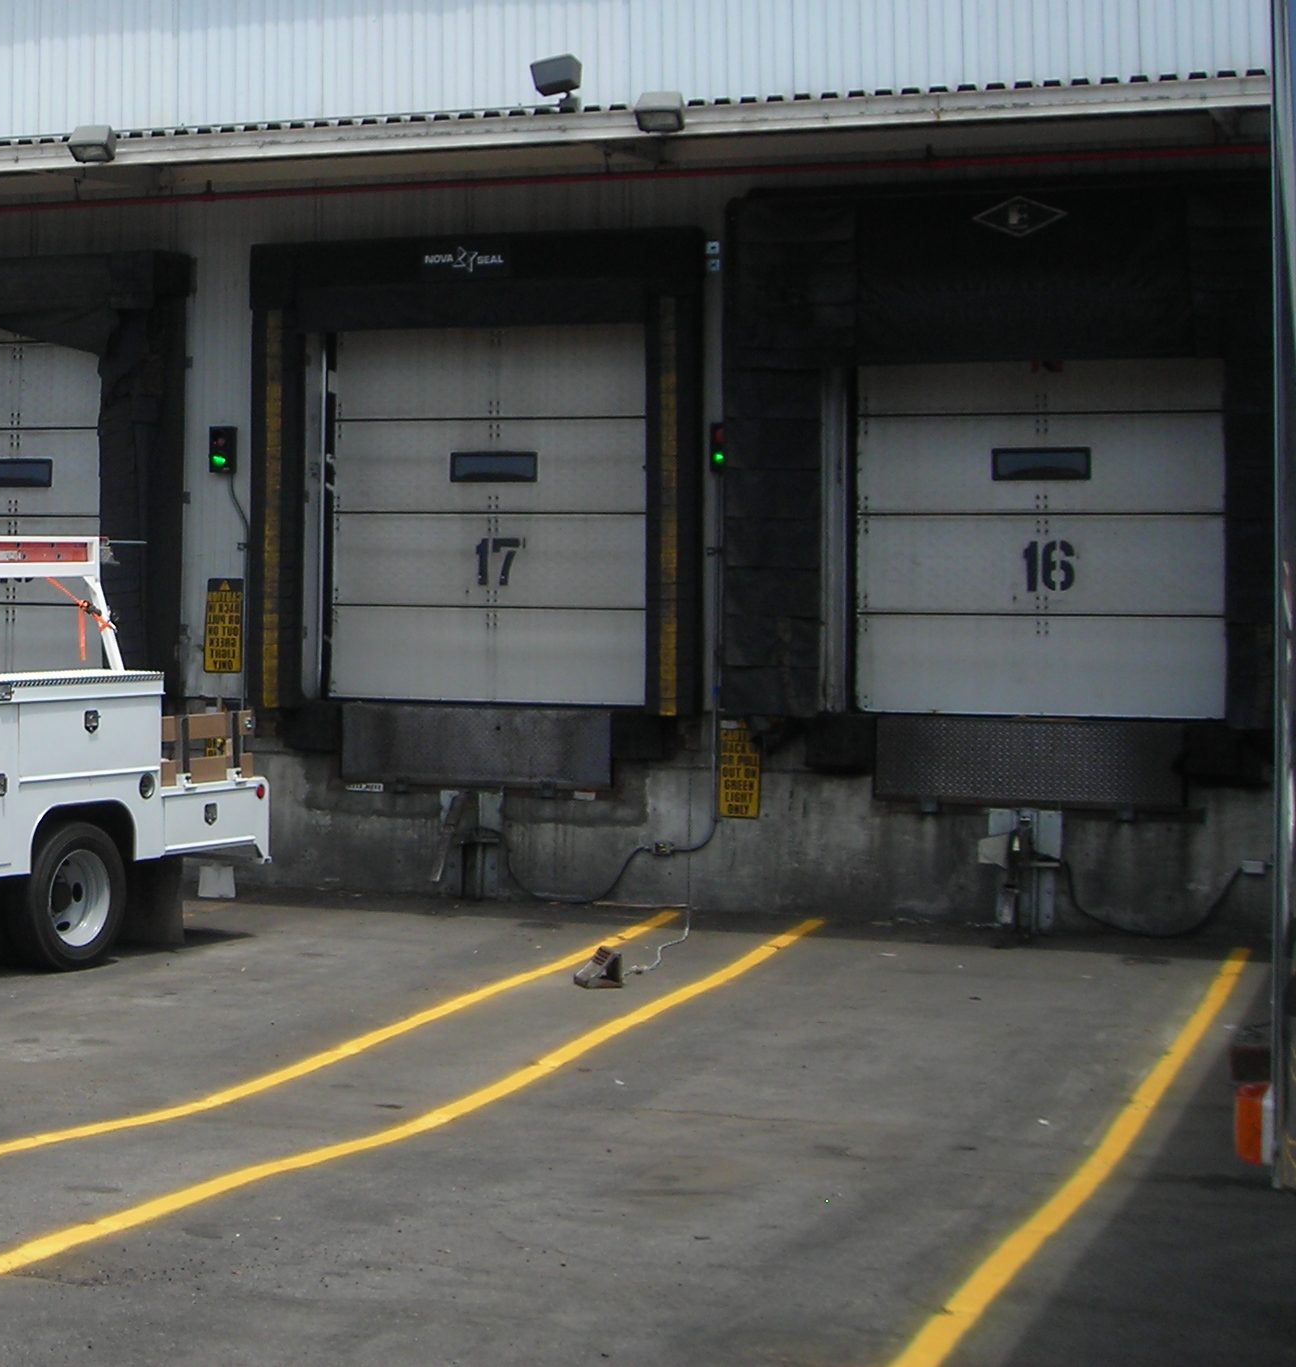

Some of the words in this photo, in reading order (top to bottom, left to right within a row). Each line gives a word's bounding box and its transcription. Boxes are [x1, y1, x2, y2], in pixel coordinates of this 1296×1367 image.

[424, 254, 454, 265] NOVA
[476, 254, 504, 265] SEAL
[475, 537, 520, 587] 17
[1023, 539, 1076, 593] 16
